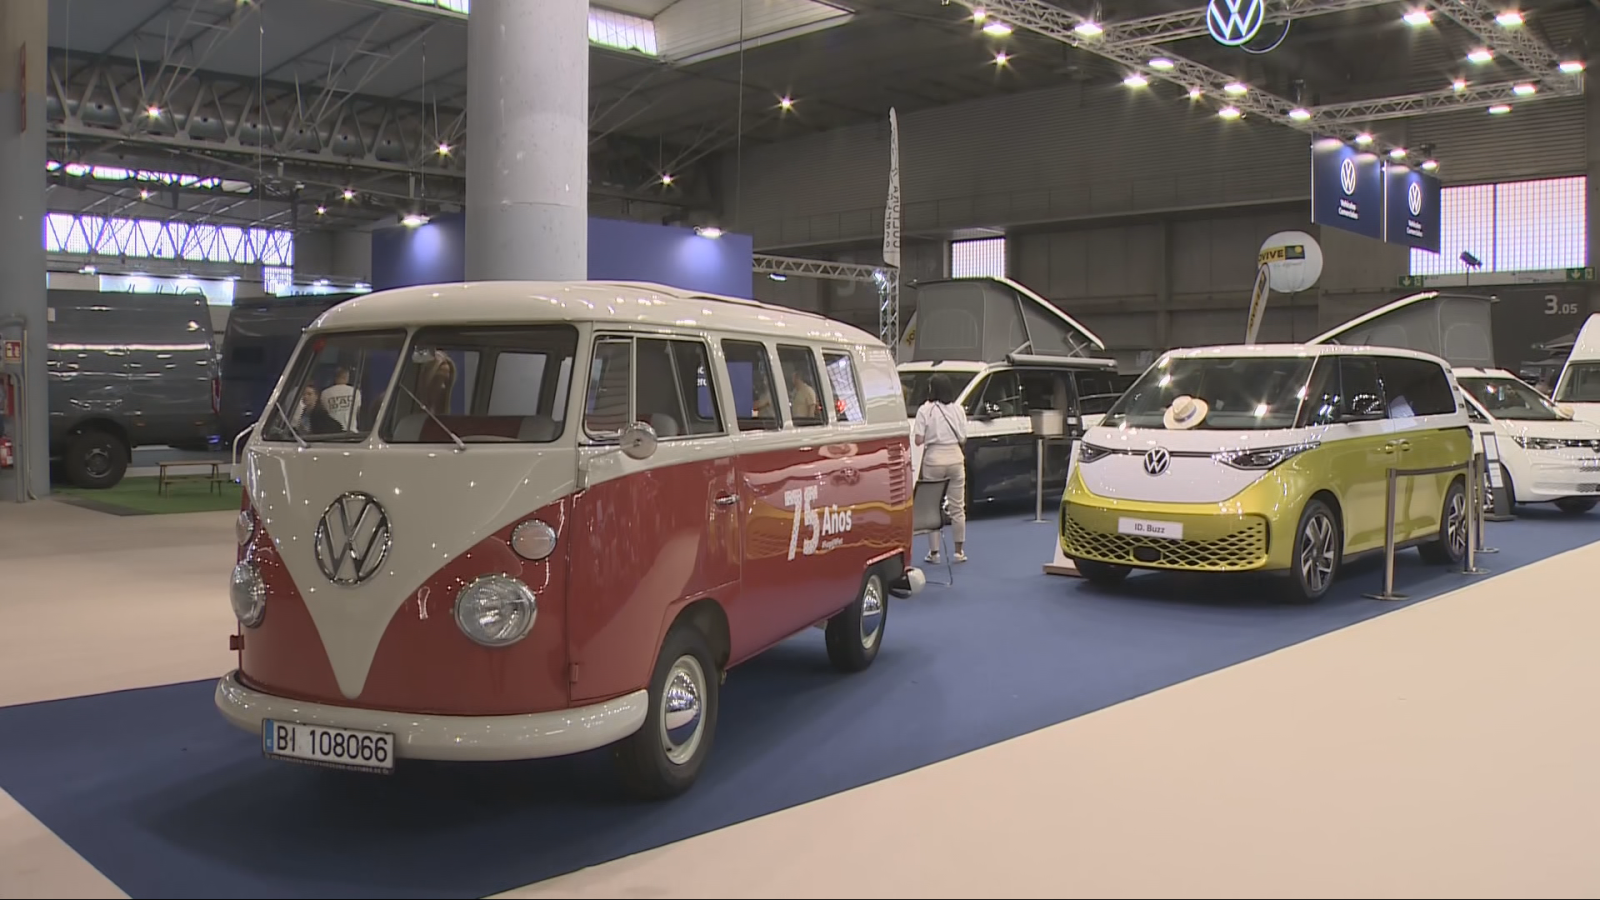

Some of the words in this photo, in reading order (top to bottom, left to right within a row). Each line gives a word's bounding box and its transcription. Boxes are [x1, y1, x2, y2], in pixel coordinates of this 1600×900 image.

[784, 485, 820, 561] 75
[822, 504, 852, 536] Años
[1146, 524, 1166, 534] Buzz
[277, 725, 296, 752] BI
[310, 729, 388, 762] 108066
